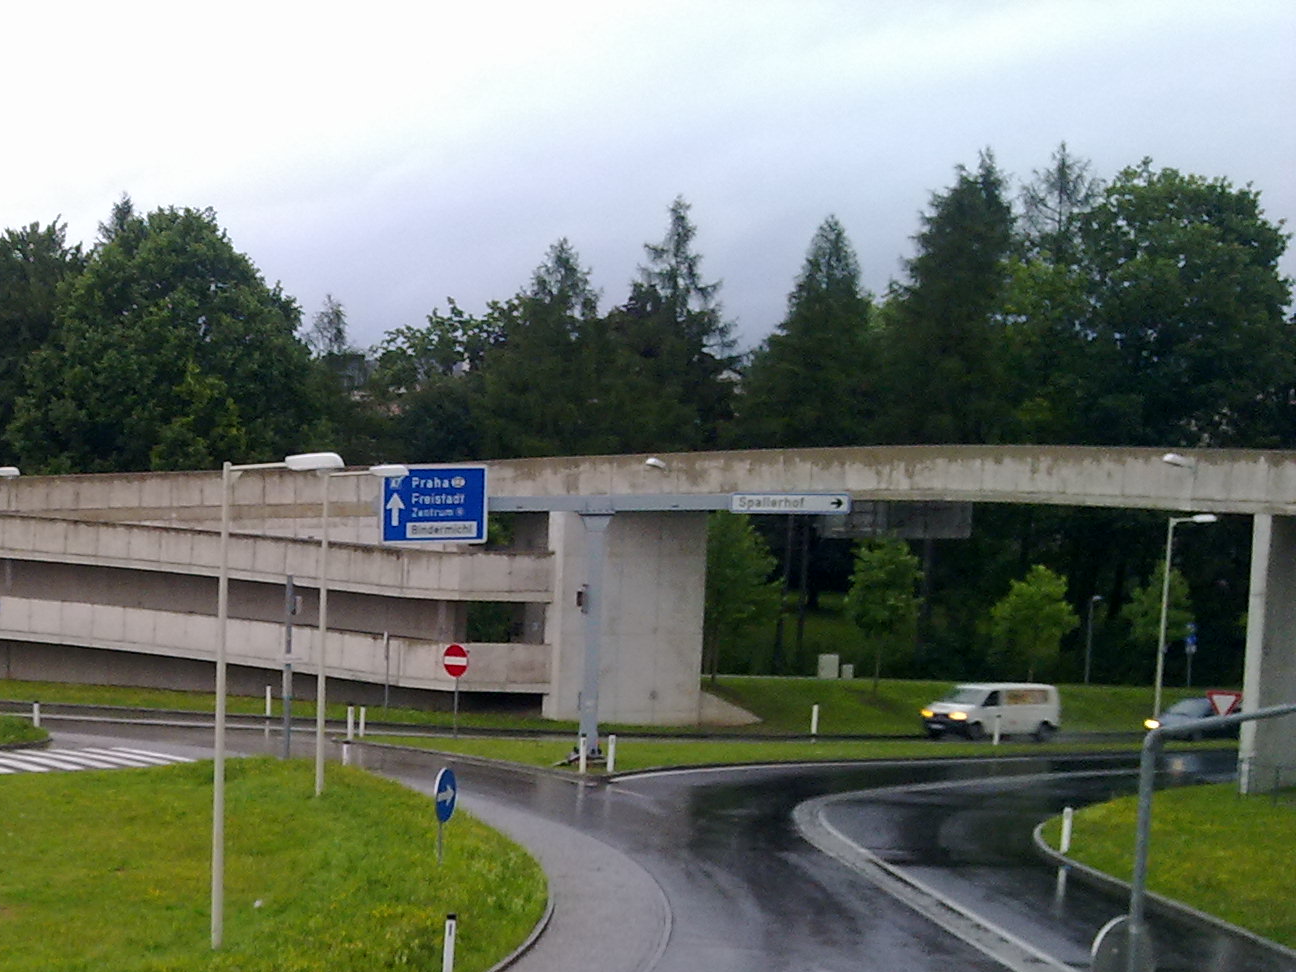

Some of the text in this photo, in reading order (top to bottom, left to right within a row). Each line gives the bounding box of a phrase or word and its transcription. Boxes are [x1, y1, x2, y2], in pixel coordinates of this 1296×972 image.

[411, 477, 449, 488] Praha
[411, 493, 465, 505] Freistadt
[739, 496, 805, 510] Spallerhof
[411, 508, 454, 518] Zentrum
